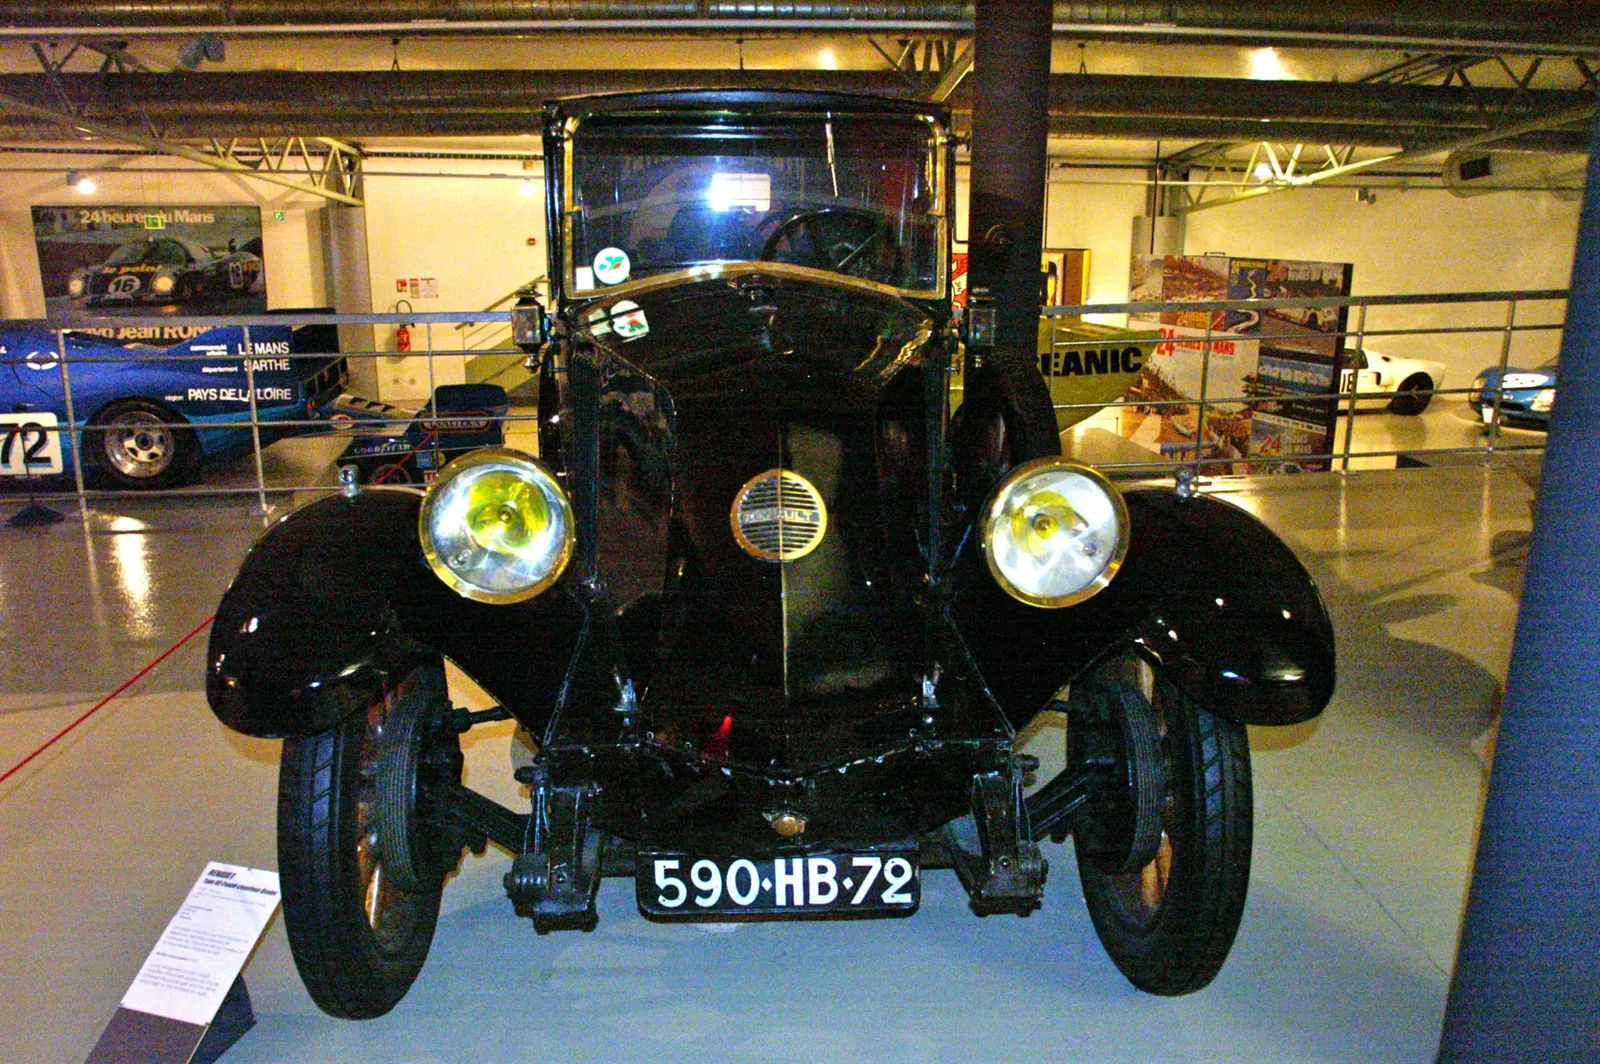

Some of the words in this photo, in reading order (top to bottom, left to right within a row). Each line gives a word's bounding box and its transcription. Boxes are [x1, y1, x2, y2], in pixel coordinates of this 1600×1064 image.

[79, 210, 99, 224] 24
[102, 210, 150, 224] heure
[174, 209, 215, 224] Mans
[117, 326, 160, 340] Jean
[238, 343, 253, 355] LE
[255, 342, 290, 355] MANS
[244, 359, 290, 372] SARTHE
[1036, 347, 1142, 377] EANIC
[188, 388, 218, 400] PAYS
[220, 388, 237, 400] DE
[256, 388, 292, 400] LOIRE
[0, 422, 52, 468] 72
